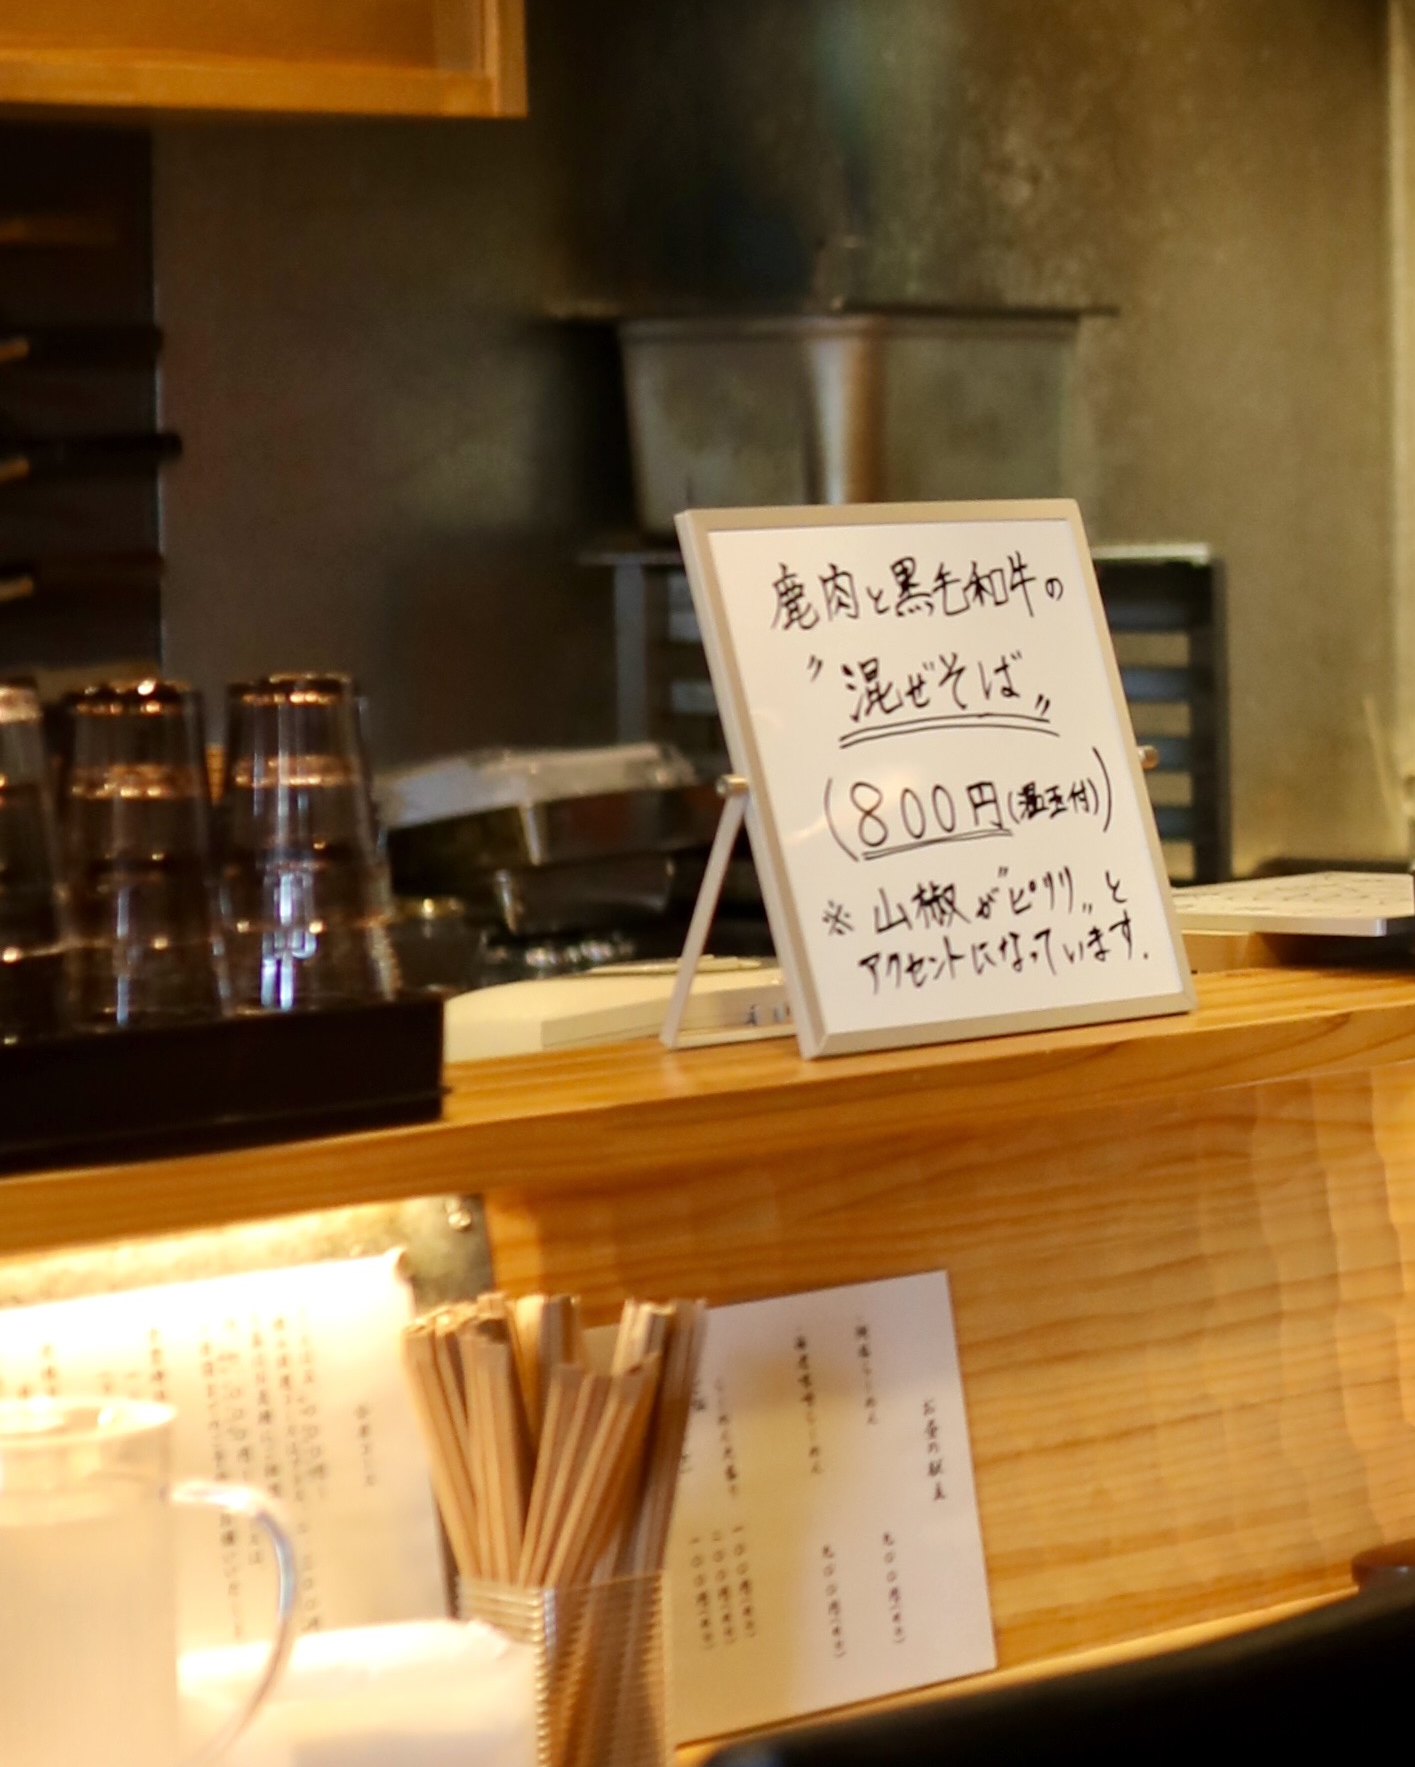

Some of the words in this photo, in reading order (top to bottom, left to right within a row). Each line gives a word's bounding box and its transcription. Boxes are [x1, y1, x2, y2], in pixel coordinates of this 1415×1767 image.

[771, 550, 1063, 631] 鹿肉と黒毛和牛の
